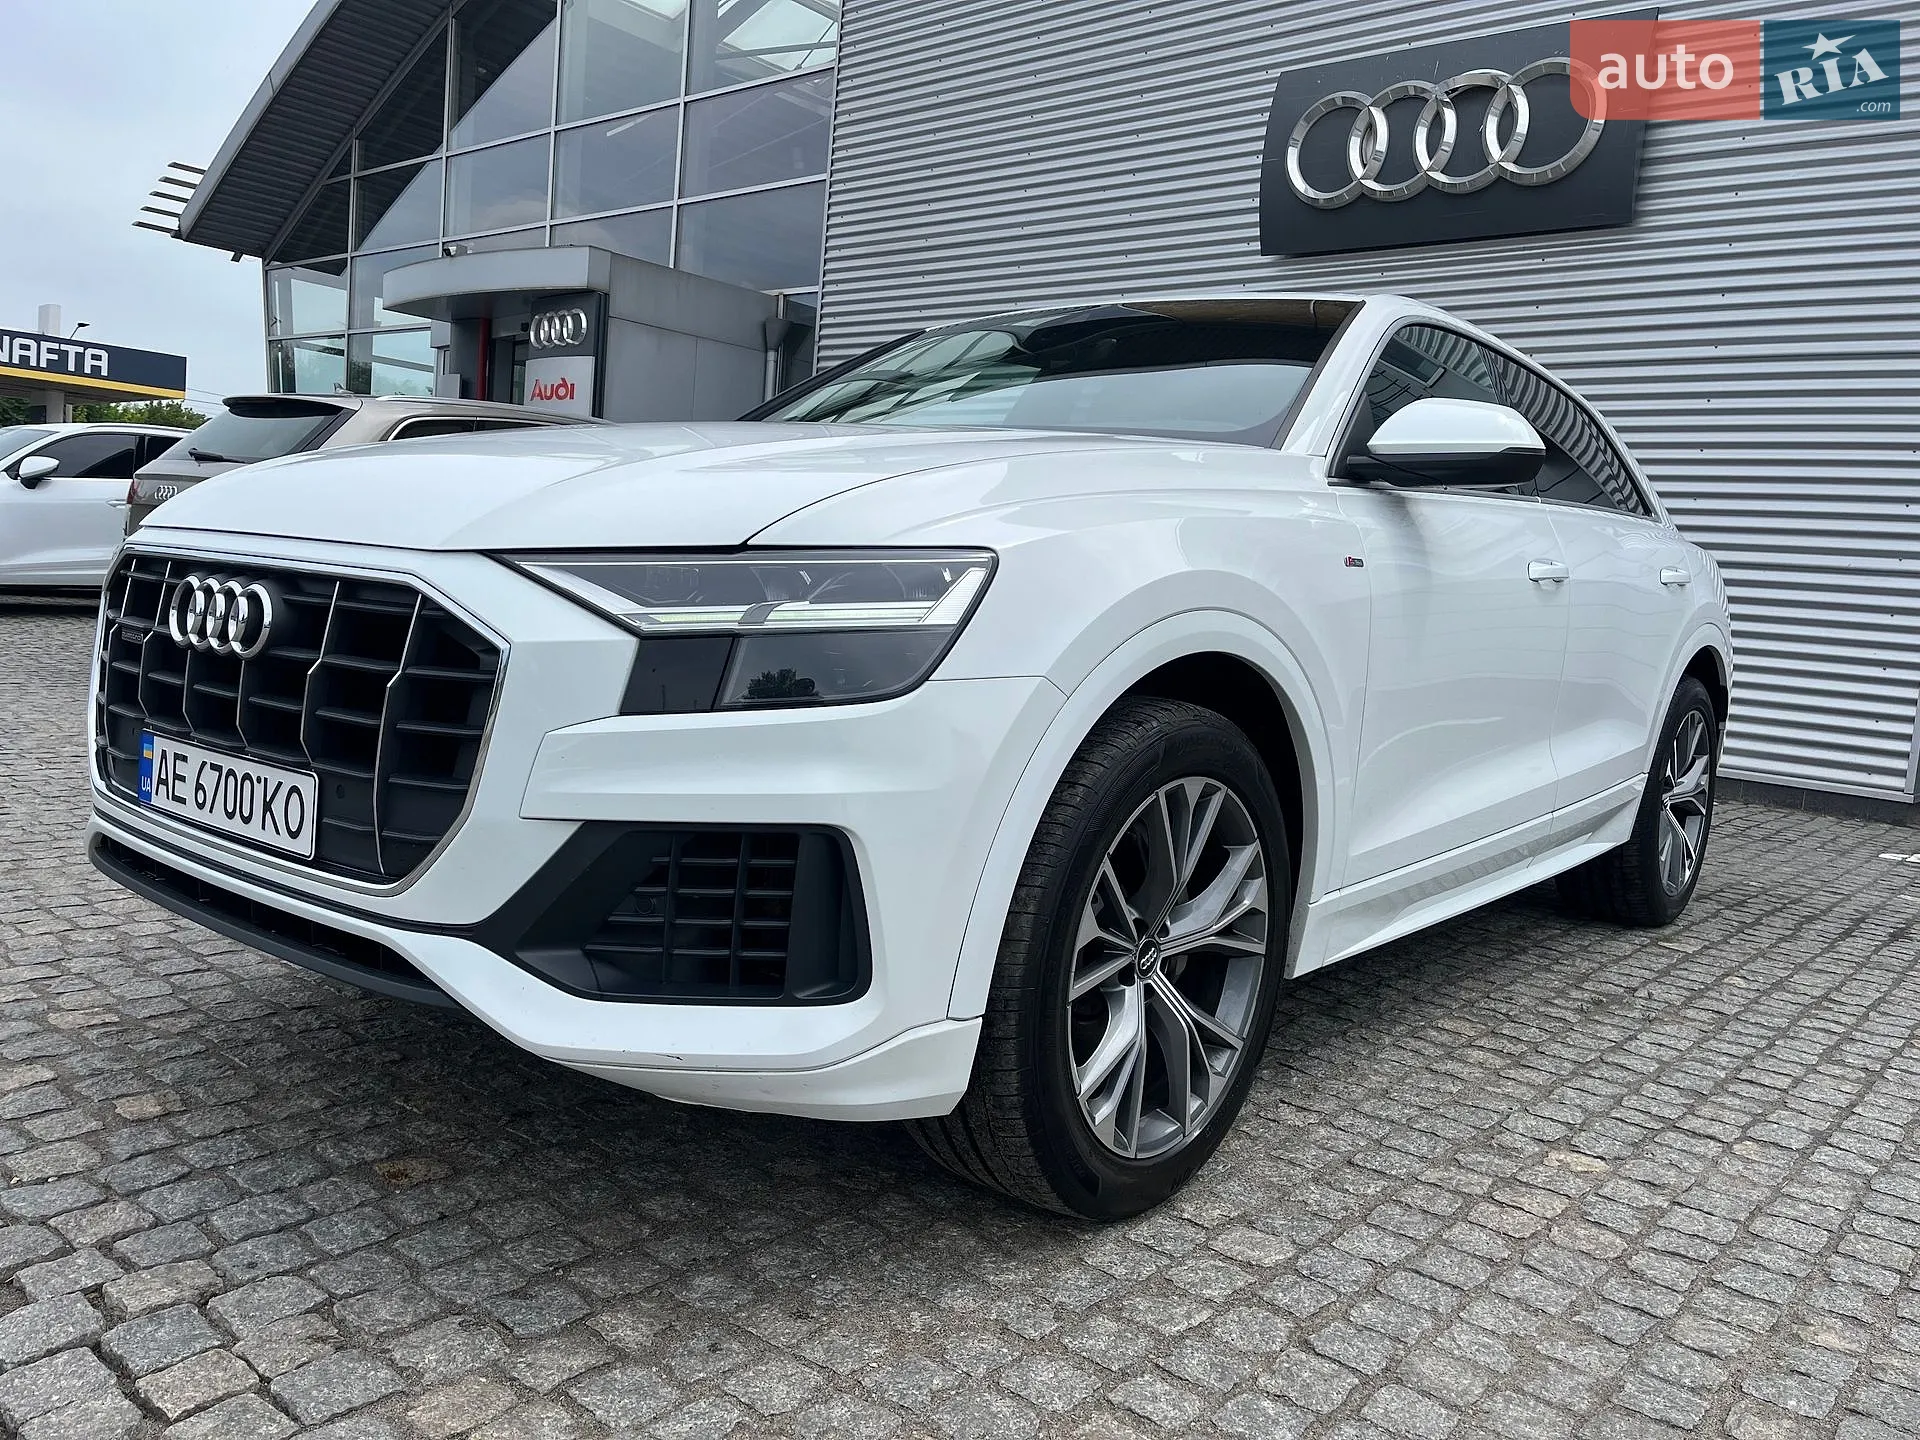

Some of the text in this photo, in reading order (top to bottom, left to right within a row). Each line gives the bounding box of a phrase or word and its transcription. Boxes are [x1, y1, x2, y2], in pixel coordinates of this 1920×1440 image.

[530, 377, 575, 401] Audi
[141, 775, 152, 793] UA
[155, 748, 305, 840] AE 6700 KO
